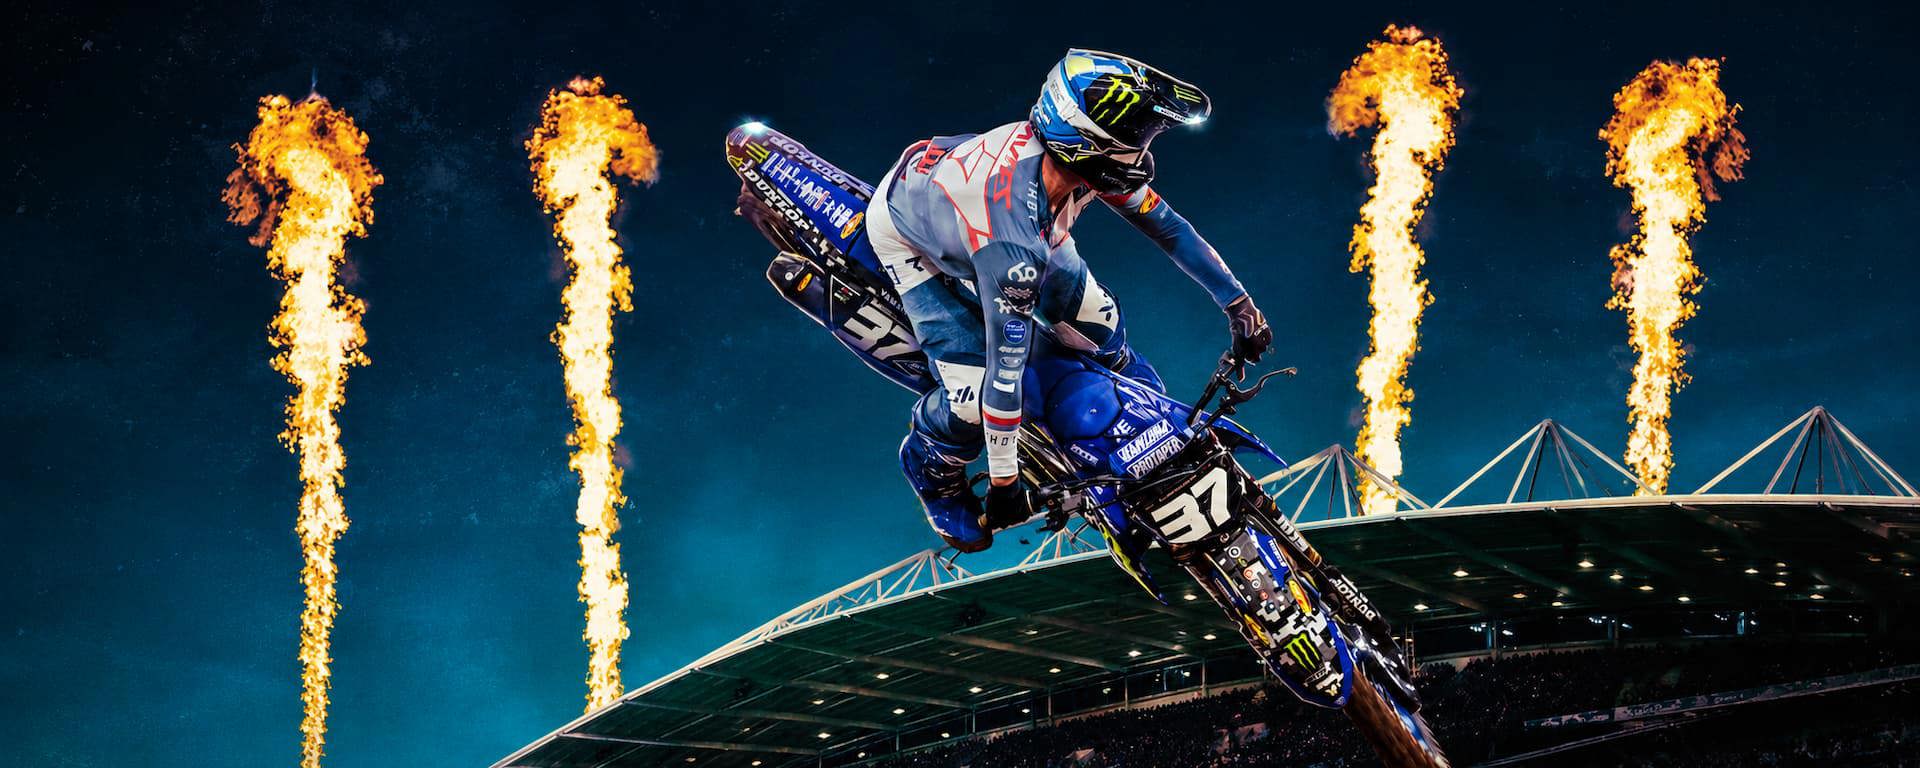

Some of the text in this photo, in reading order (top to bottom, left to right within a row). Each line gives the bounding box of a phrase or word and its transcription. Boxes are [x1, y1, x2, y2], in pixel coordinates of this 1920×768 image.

[769, 136, 849, 184] DUNLOP
[743, 168, 810, 231] DUNLOP
[1131, 437, 1184, 479] PROTAPER
[1151, 466, 1231, 544] 37
[1331, 578, 1377, 621] DUNLOP
